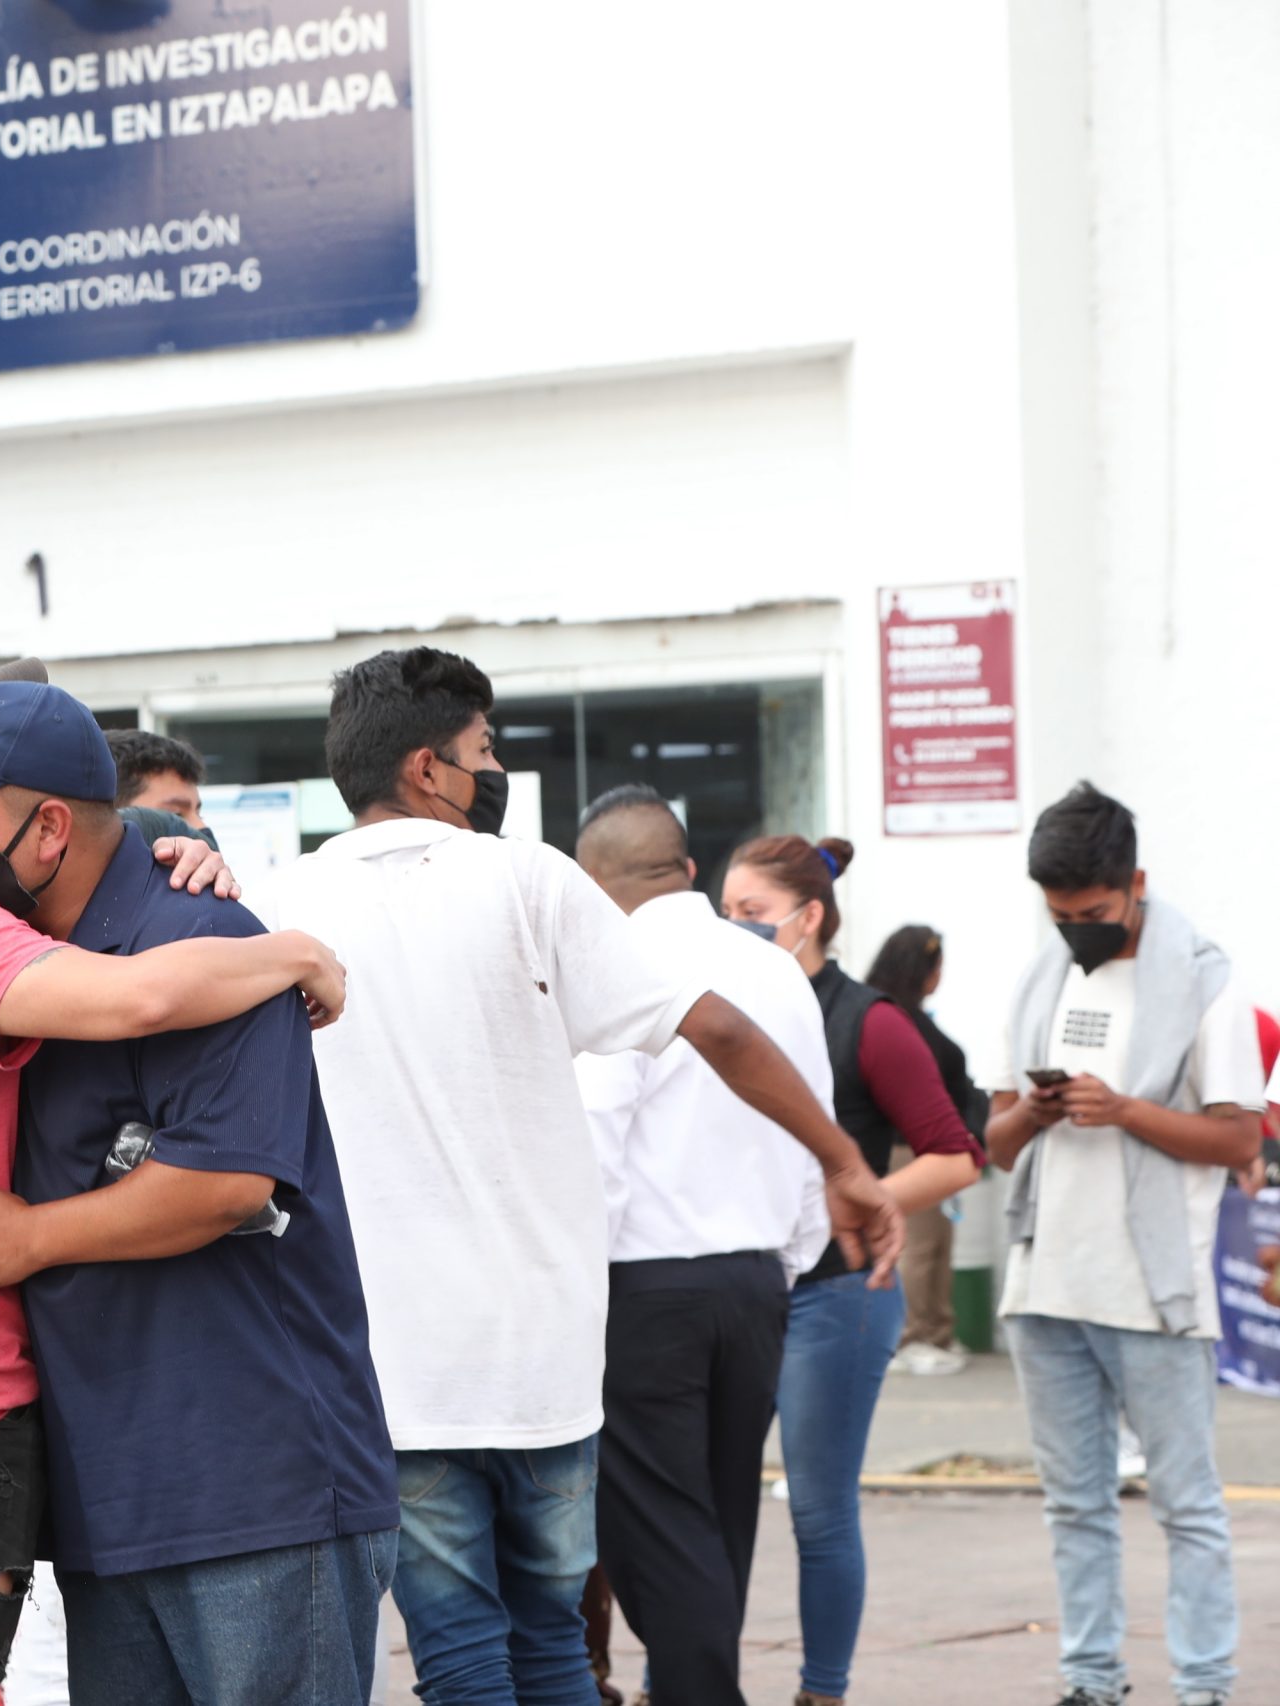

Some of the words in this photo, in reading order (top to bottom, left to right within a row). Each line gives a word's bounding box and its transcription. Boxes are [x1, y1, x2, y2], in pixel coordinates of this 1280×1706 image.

[49, 54, 99, 95] DE
[106, 8, 388, 88] INVESTIGACIÓN
[111, 103, 162, 144] EN
[169, 70, 399, 135] IZTAPALAPA
[181, 258, 262, 300] IZP-6
